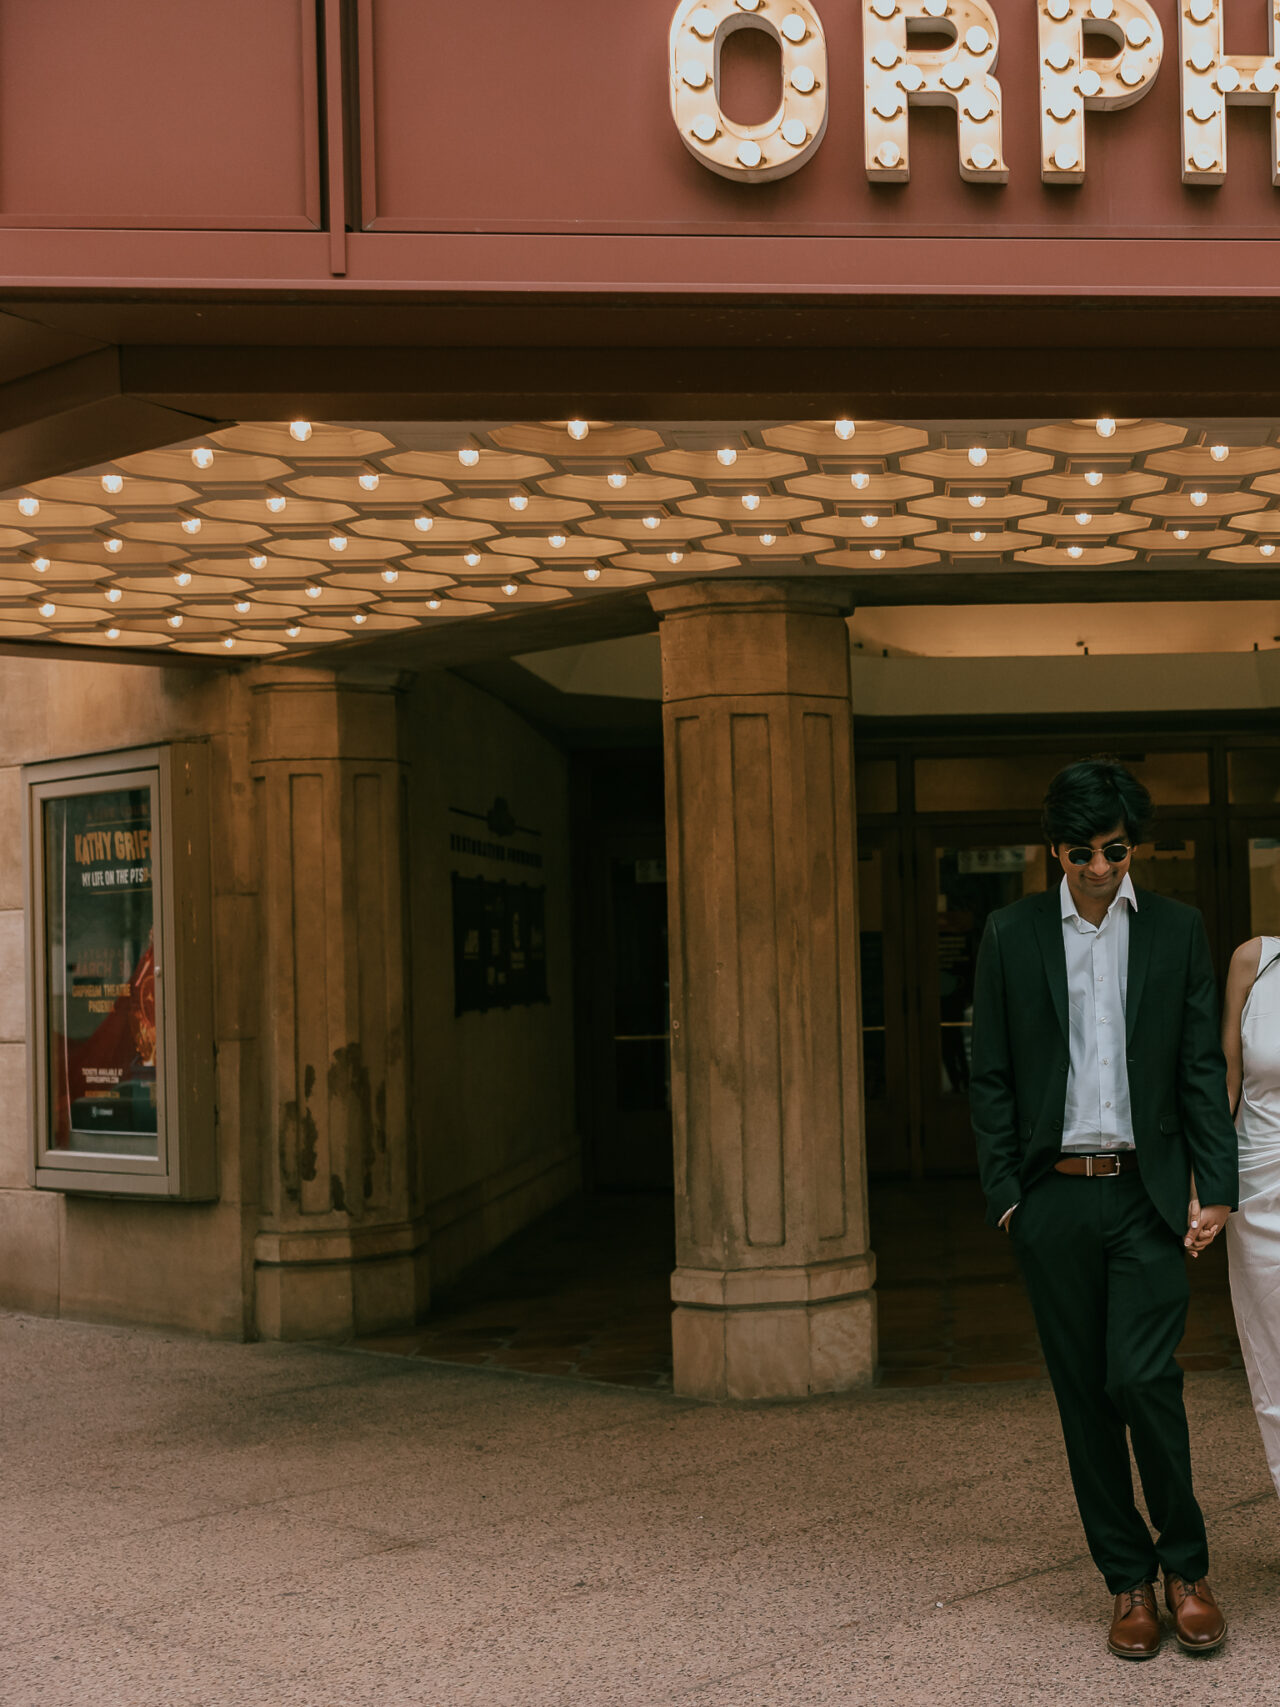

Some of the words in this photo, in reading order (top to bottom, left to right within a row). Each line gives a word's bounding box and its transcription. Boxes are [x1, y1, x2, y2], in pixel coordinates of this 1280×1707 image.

[74, 831, 112, 865] KATHY
[114, 830, 152, 861] GRIF
[82, 872, 91, 887] MY
[91, 870, 105, 887] LIFE
[105, 869, 115, 886] ON
[116, 869, 129, 884] THE
[103, 983, 132, 998] THEATRE
